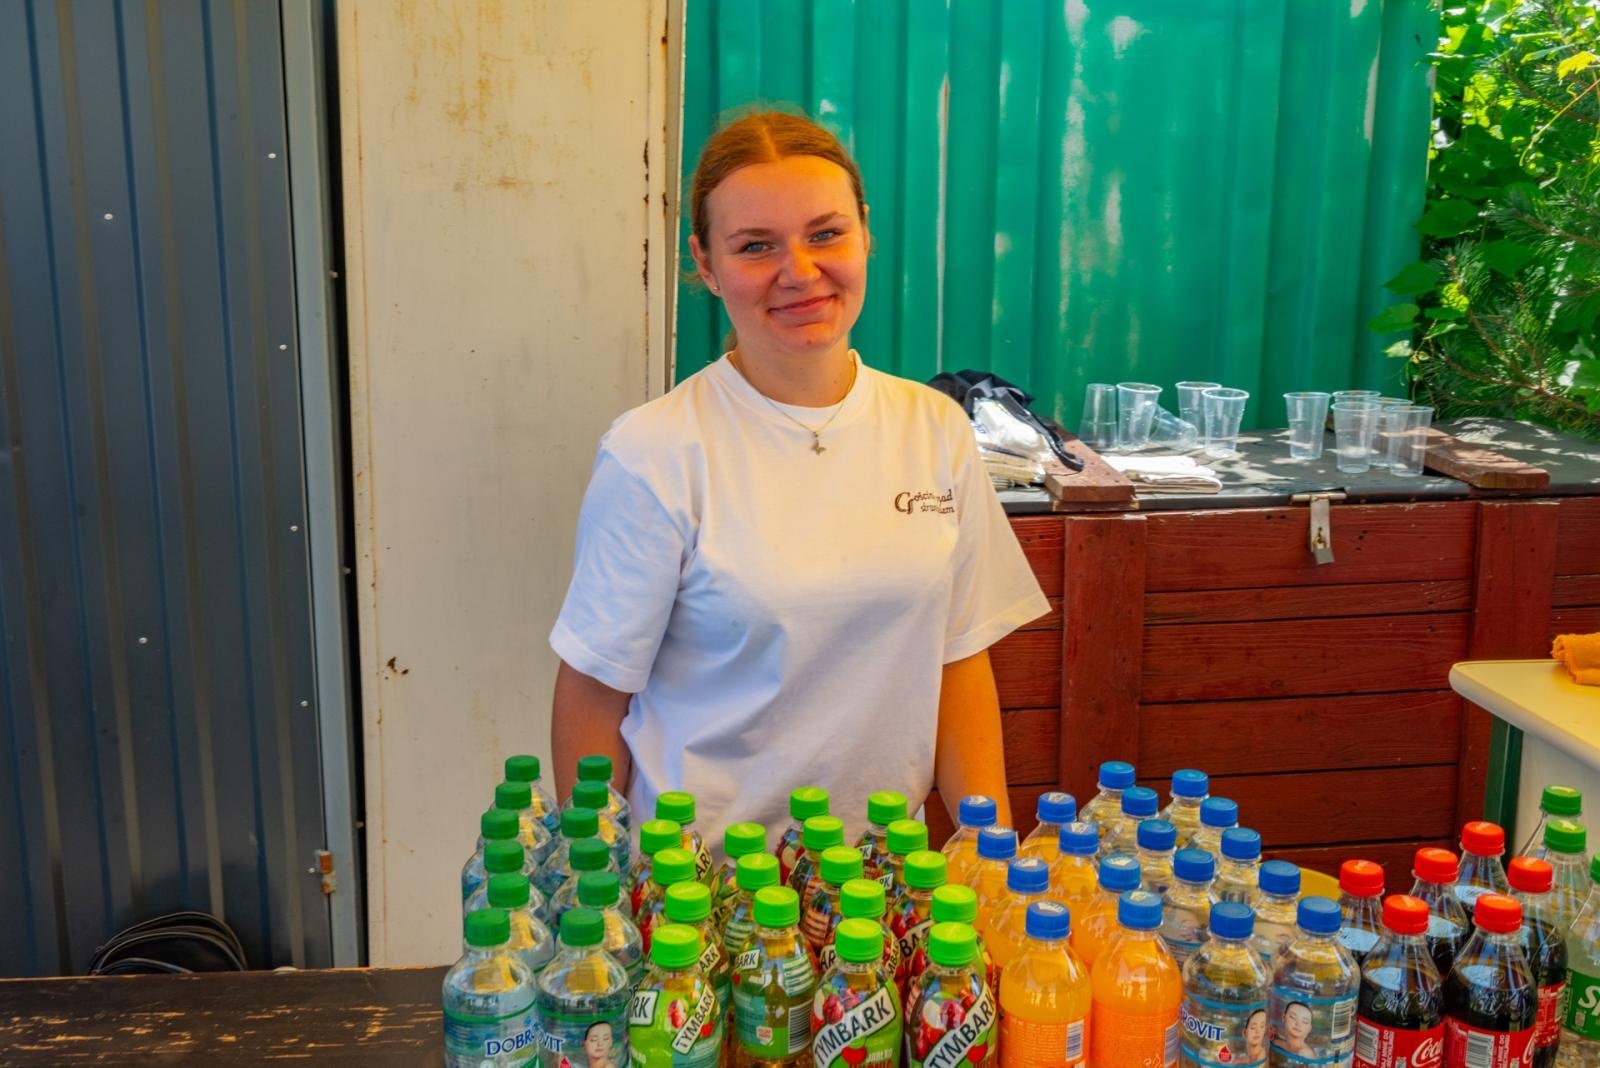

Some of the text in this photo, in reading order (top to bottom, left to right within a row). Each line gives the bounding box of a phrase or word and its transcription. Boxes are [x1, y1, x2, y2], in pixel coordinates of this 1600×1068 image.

[676, 990, 714, 1048] TYMBARK
[814, 996, 891, 1066] TYMBARK
[928, 991, 995, 1068] TYMBARK
